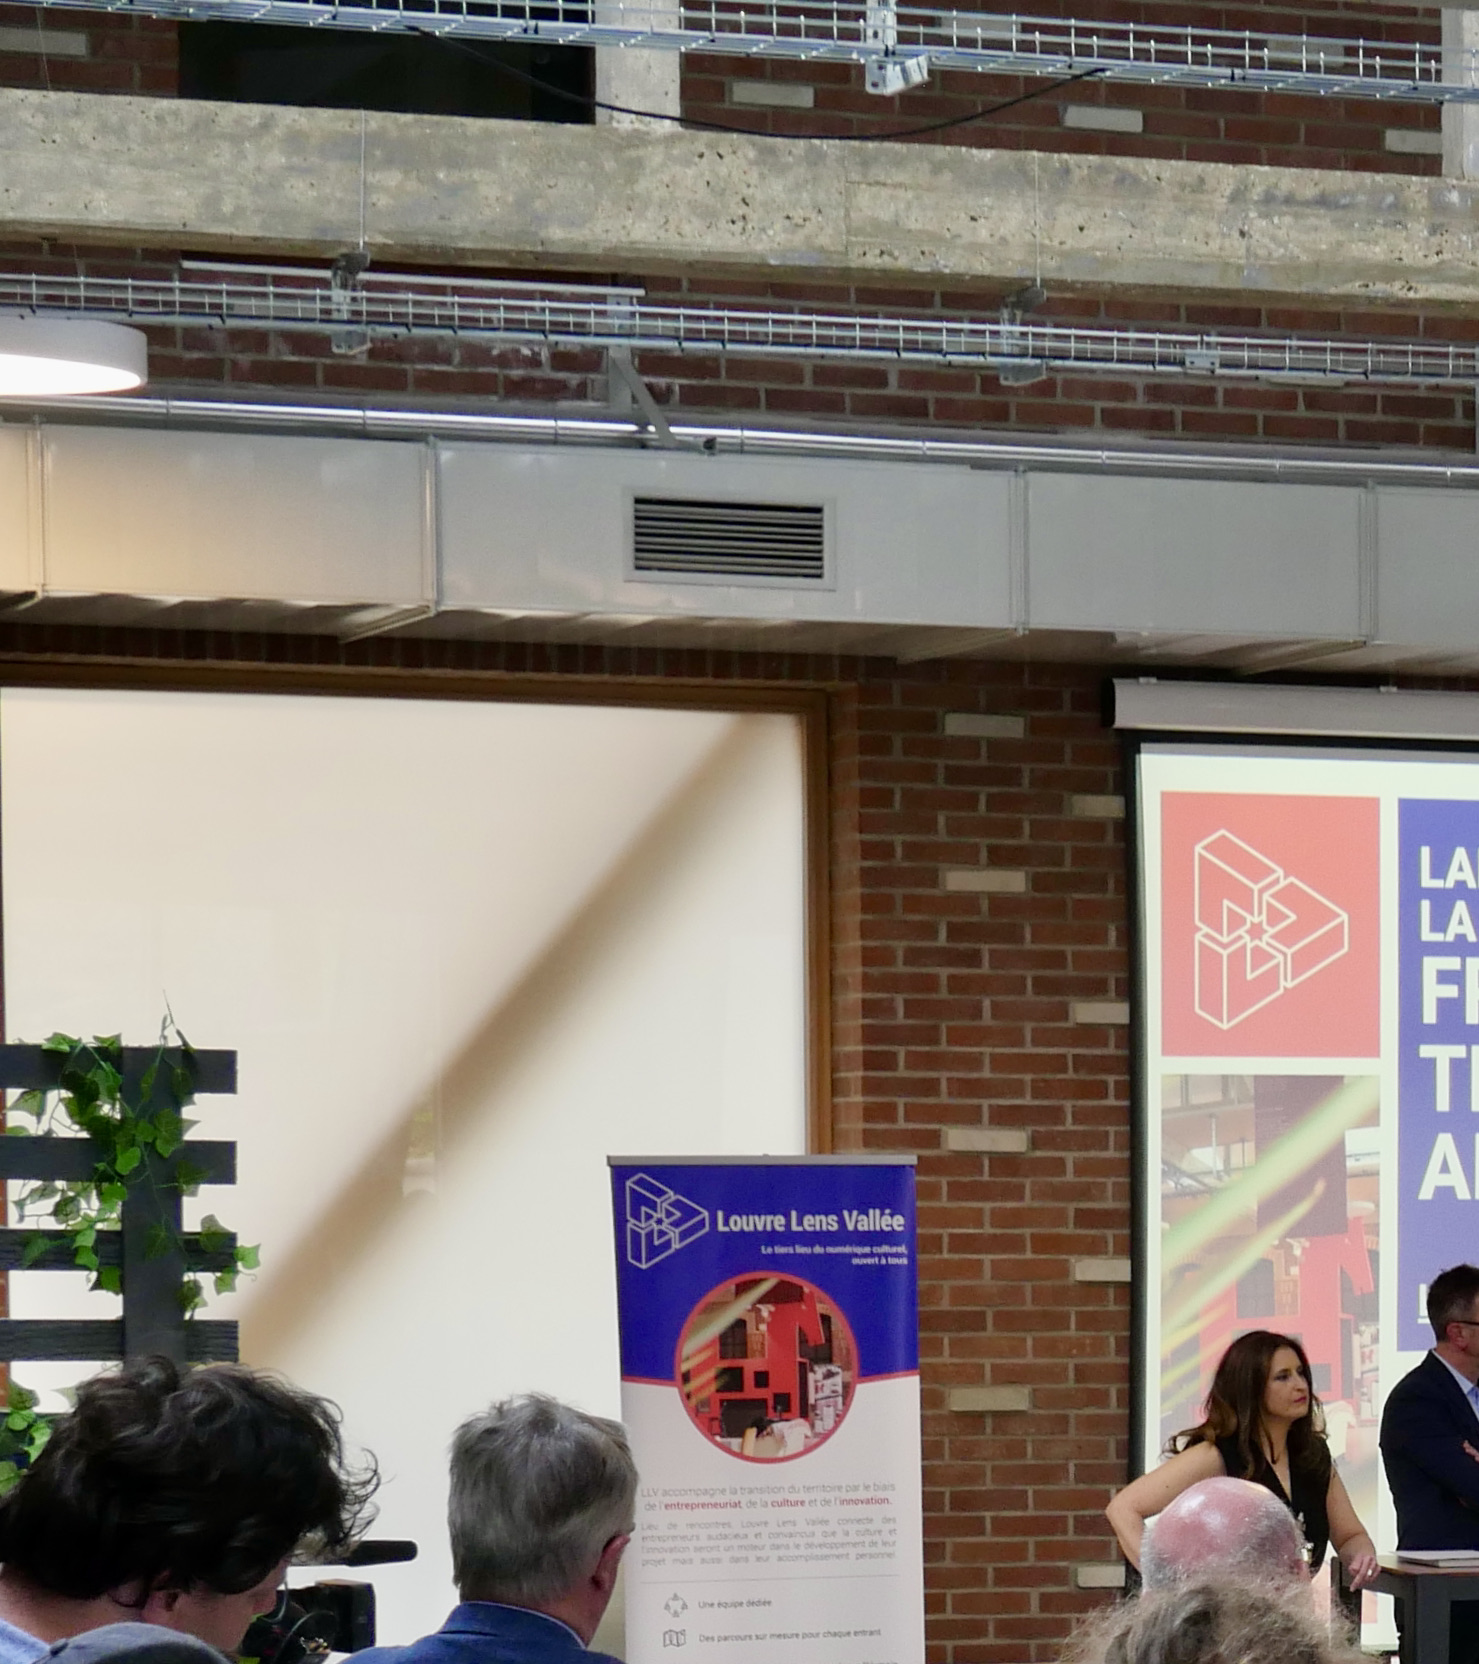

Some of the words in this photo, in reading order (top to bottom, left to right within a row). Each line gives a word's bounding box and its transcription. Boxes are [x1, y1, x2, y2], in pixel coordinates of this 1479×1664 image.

[1420, 901, 1477, 942] LA
[716, 1210, 786, 1232] Louvre
[790, 1210, 838, 1232] Lens
[843, 1208, 905, 1232] Vallée
[852, 1257, 879, 1265] ouvert
[888, 1256, 908, 1265] tous
[770, 1498, 806, 1508] culture
